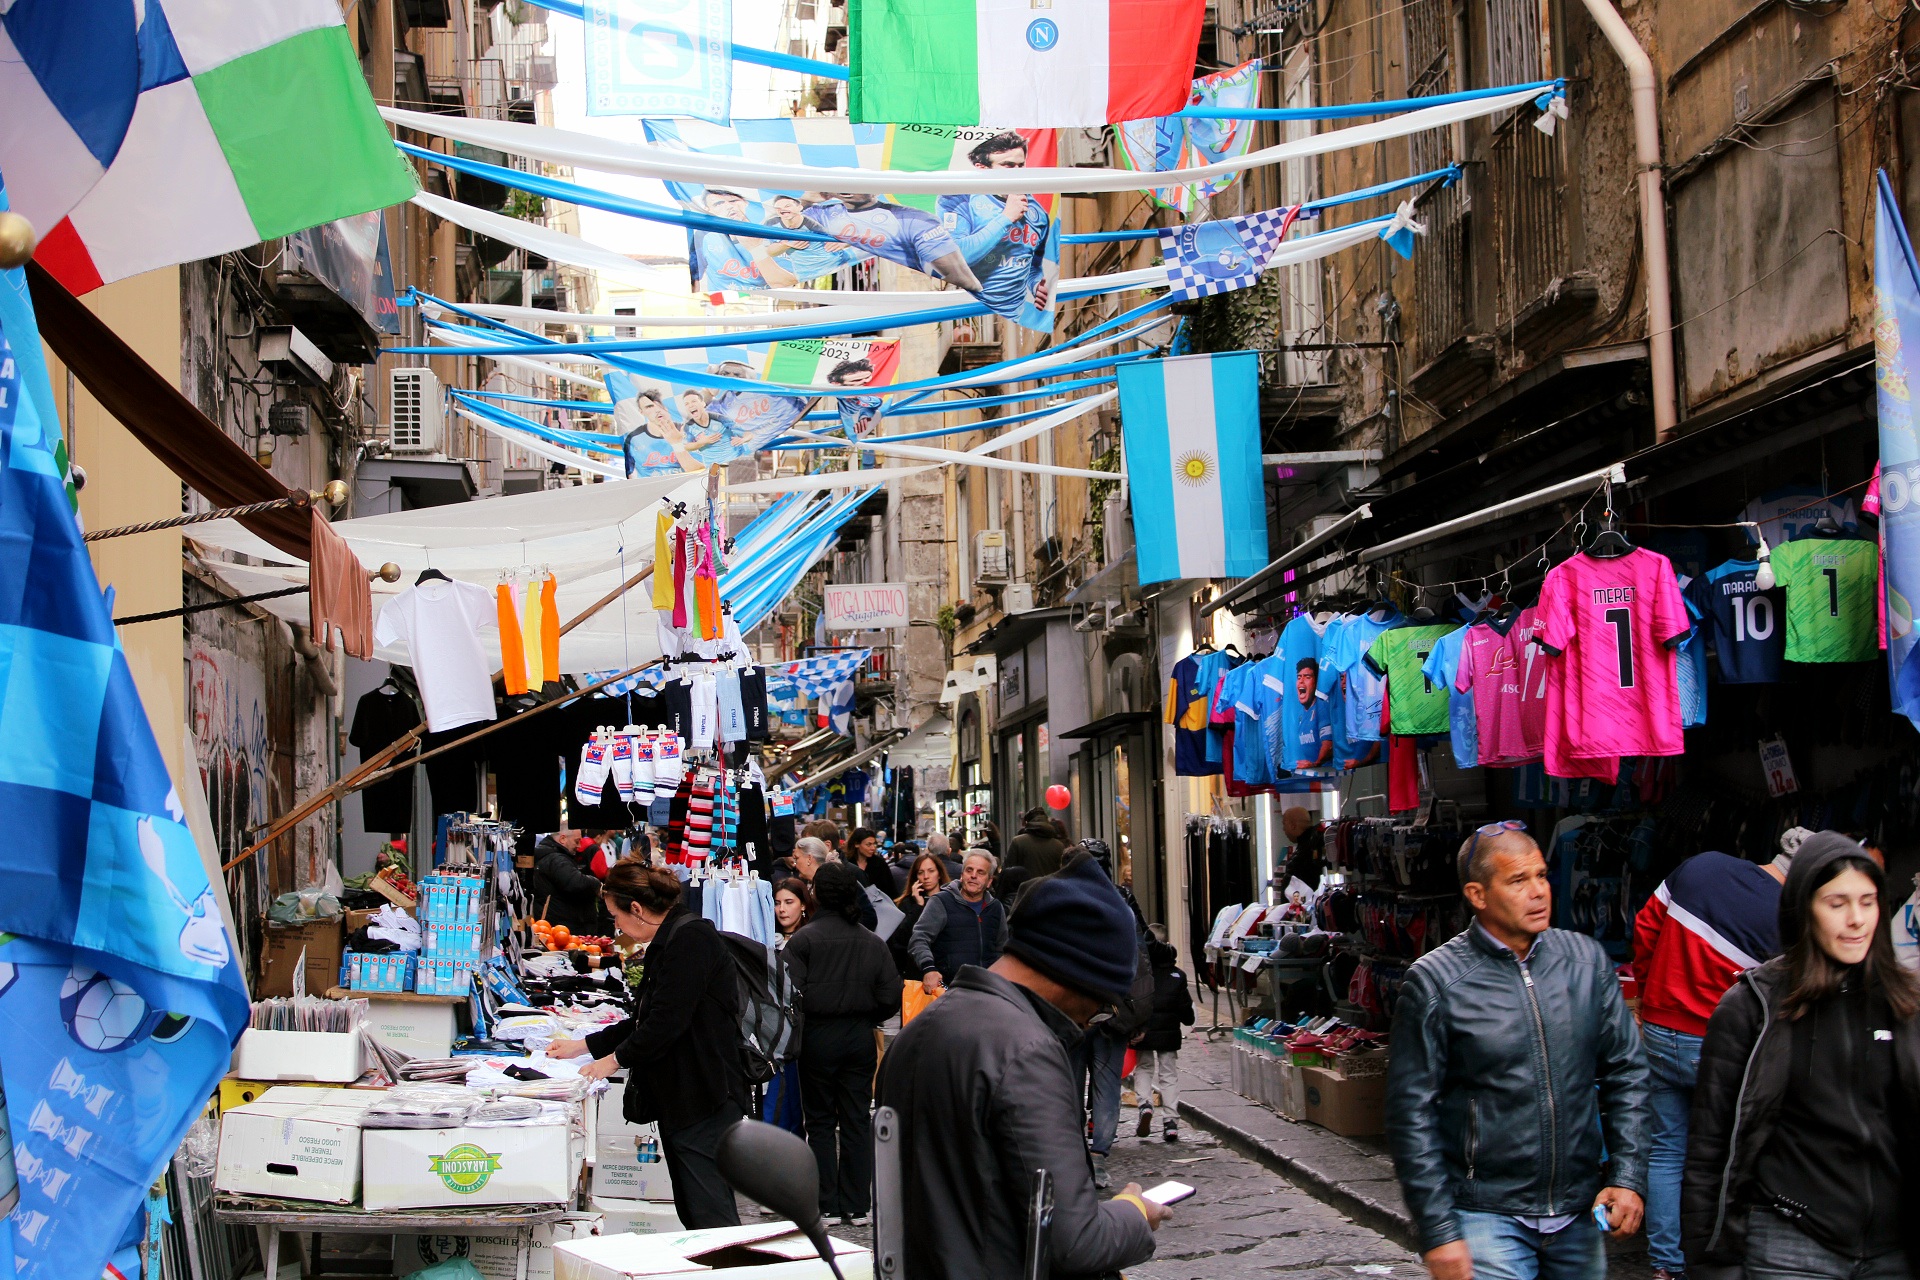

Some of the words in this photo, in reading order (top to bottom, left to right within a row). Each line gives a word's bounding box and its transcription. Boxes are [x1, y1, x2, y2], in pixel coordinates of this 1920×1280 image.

[1034, 26, 1049, 43] N
[1001, 223, 1039, 247] ete
[717, 258, 762, 279] Let
[1593, 586, 1637, 606] MERET
[1822, 568, 1839, 617] 1
[827, 591, 860, 621] MEGA
[863, 589, 905, 618] INTIMO
[1731, 595, 1774, 642] 10
[1604, 607, 1635, 689] 1
[1416, 651, 1433, 694] 1
[298, 1136, 321, 1145] FRESCO
[321, 1138, 341, 1147] LUOGO
[291, 1154, 323, 1164] DEPERIBILE
[311, 1147, 333, 1156] TENERE
[323, 1157, 344, 1166] MERCE
[442, 1160, 489, 1174] TARASCONI
[475, 1236, 509, 1246] BOSCHI
